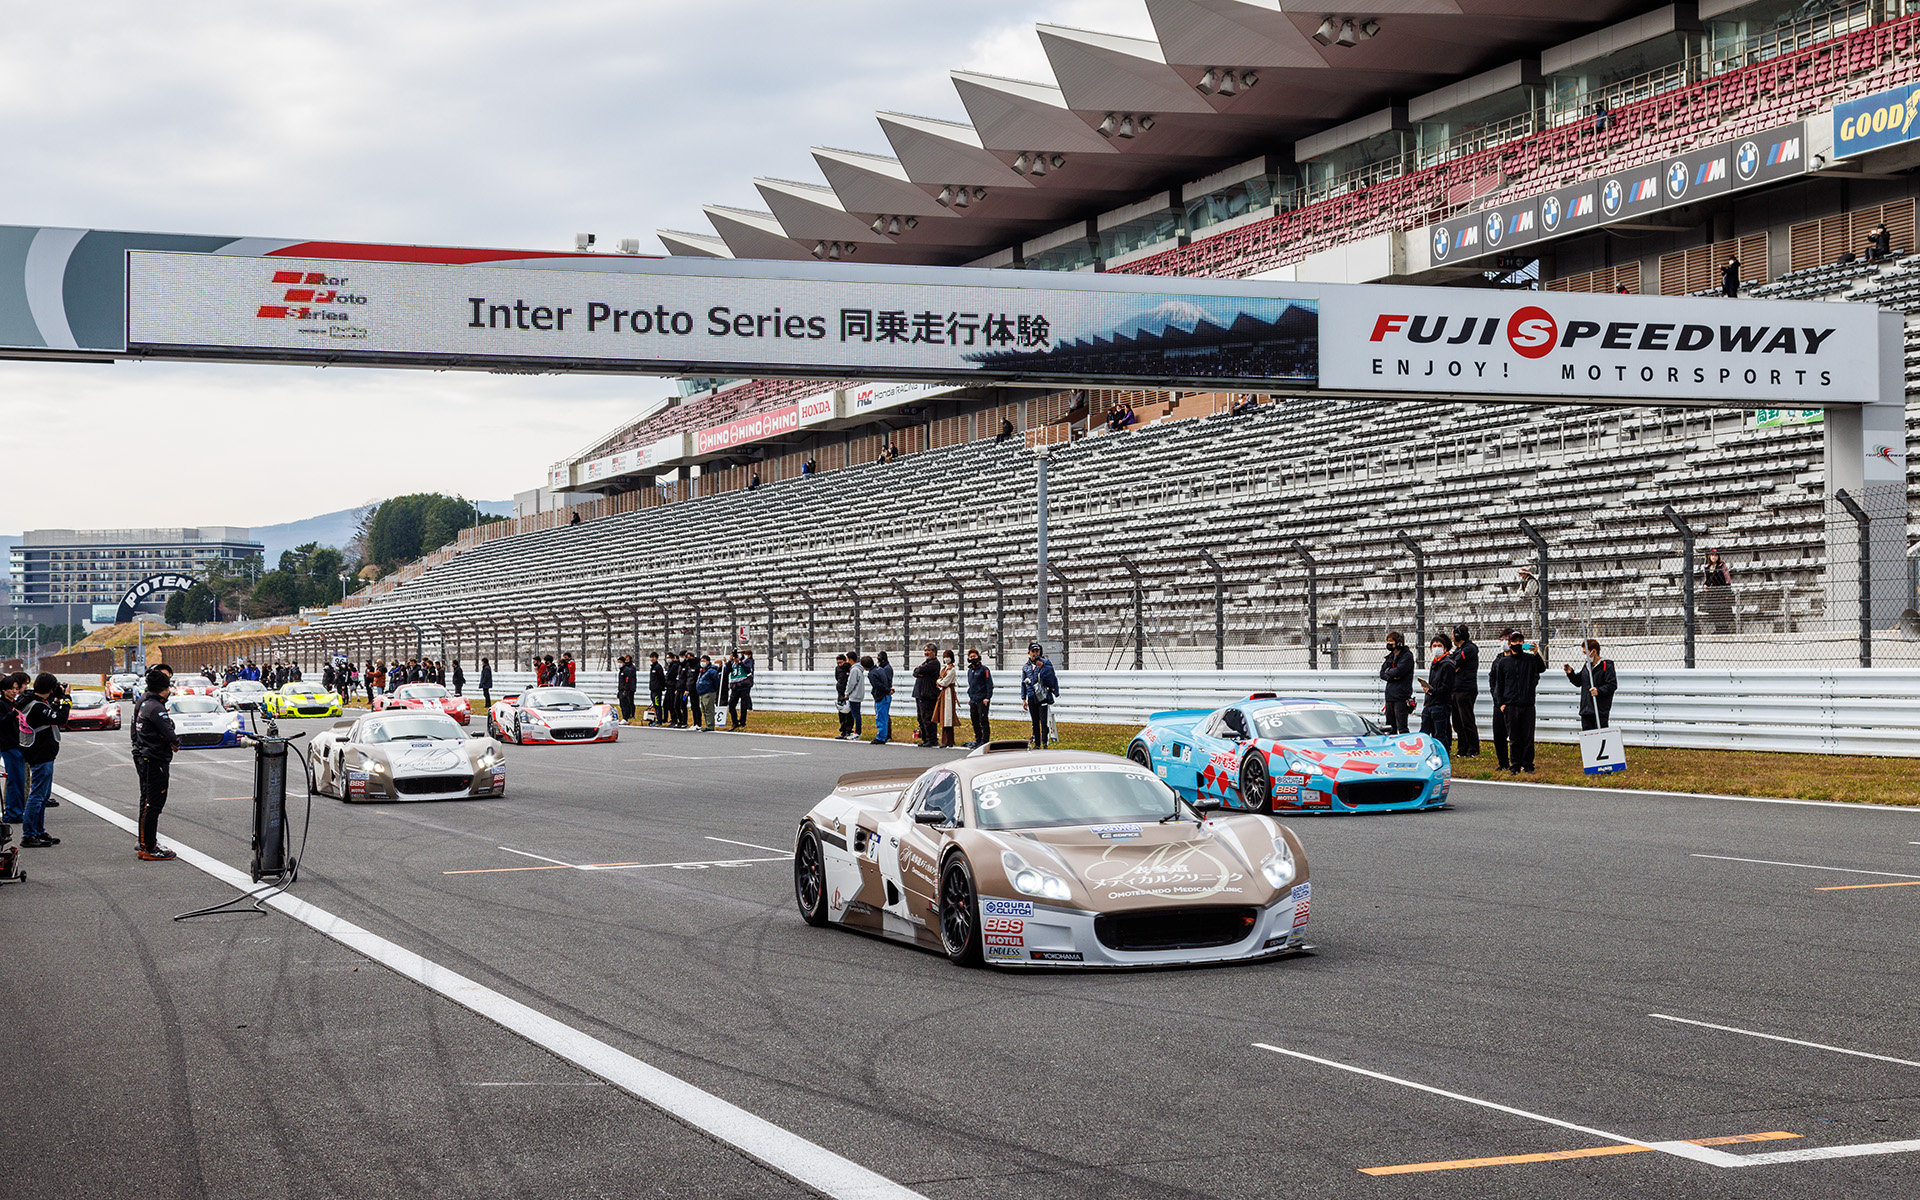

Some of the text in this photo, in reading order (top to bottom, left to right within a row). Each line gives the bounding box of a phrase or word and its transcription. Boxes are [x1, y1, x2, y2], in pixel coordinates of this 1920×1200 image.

[1840, 103, 1904, 141] GOOD
[468, 297, 1050, 347] Inter Proto Series 同乗走行体験
[1372, 358, 1831, 386] ENJOY! MOTORSPORTS
[874, 388, 895, 400] Honda
[801, 400, 831, 418] HONDA
[738, 421, 762, 439] HINO
[772, 411, 797, 431] HINO
[707, 429, 729, 448] HINO
[125, 576, 197, 608] POTEN
[1259, 718, 1284, 730] 16
[1030, 764, 1101, 774] KI-PROMOTE
[838, 782, 910, 792] OMOTESAND
[974, 774, 1047, 794] YAMAZAKI
[1276, 785, 1298, 793] BBS
[979, 790, 1001, 810] 8
[1093, 872, 1243, 890] メディカルクリニック
[1108, 888, 1171, 899] OMOTESANDO
[996, 901, 1031, 909] OGURA
[985, 918, 1023, 932] BBS
[986, 935, 1022, 945] MOTUL
[988, 946, 1020, 955] ENDLESS
